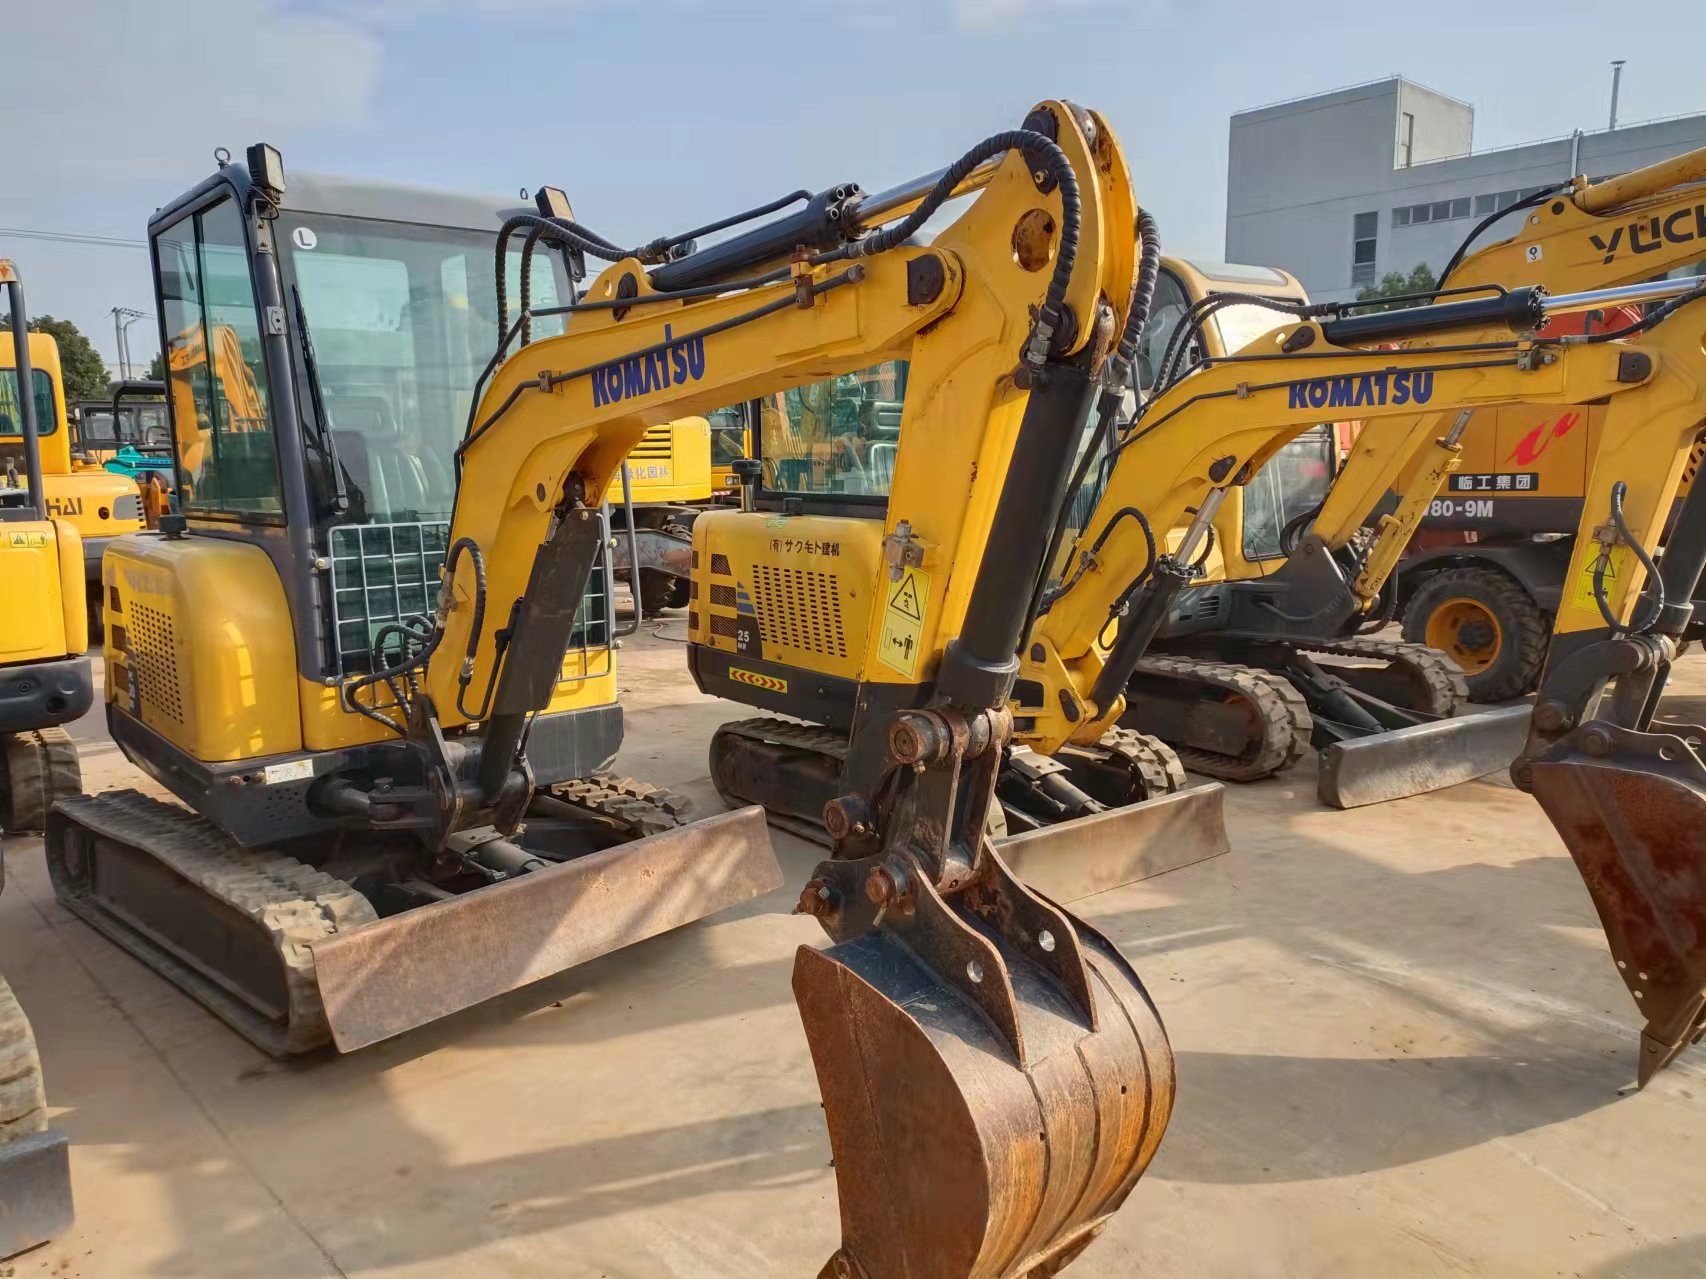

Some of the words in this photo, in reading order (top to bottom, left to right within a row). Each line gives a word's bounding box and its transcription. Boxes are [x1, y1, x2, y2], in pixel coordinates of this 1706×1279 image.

[298, 230, 312, 246] L
[591, 323, 705, 408] KOMATSU
[1288, 366, 1434, 409] KOMATSU
[1458, 474, 1531, 490] 临工集团
[737, 630, 750, 643] 25
